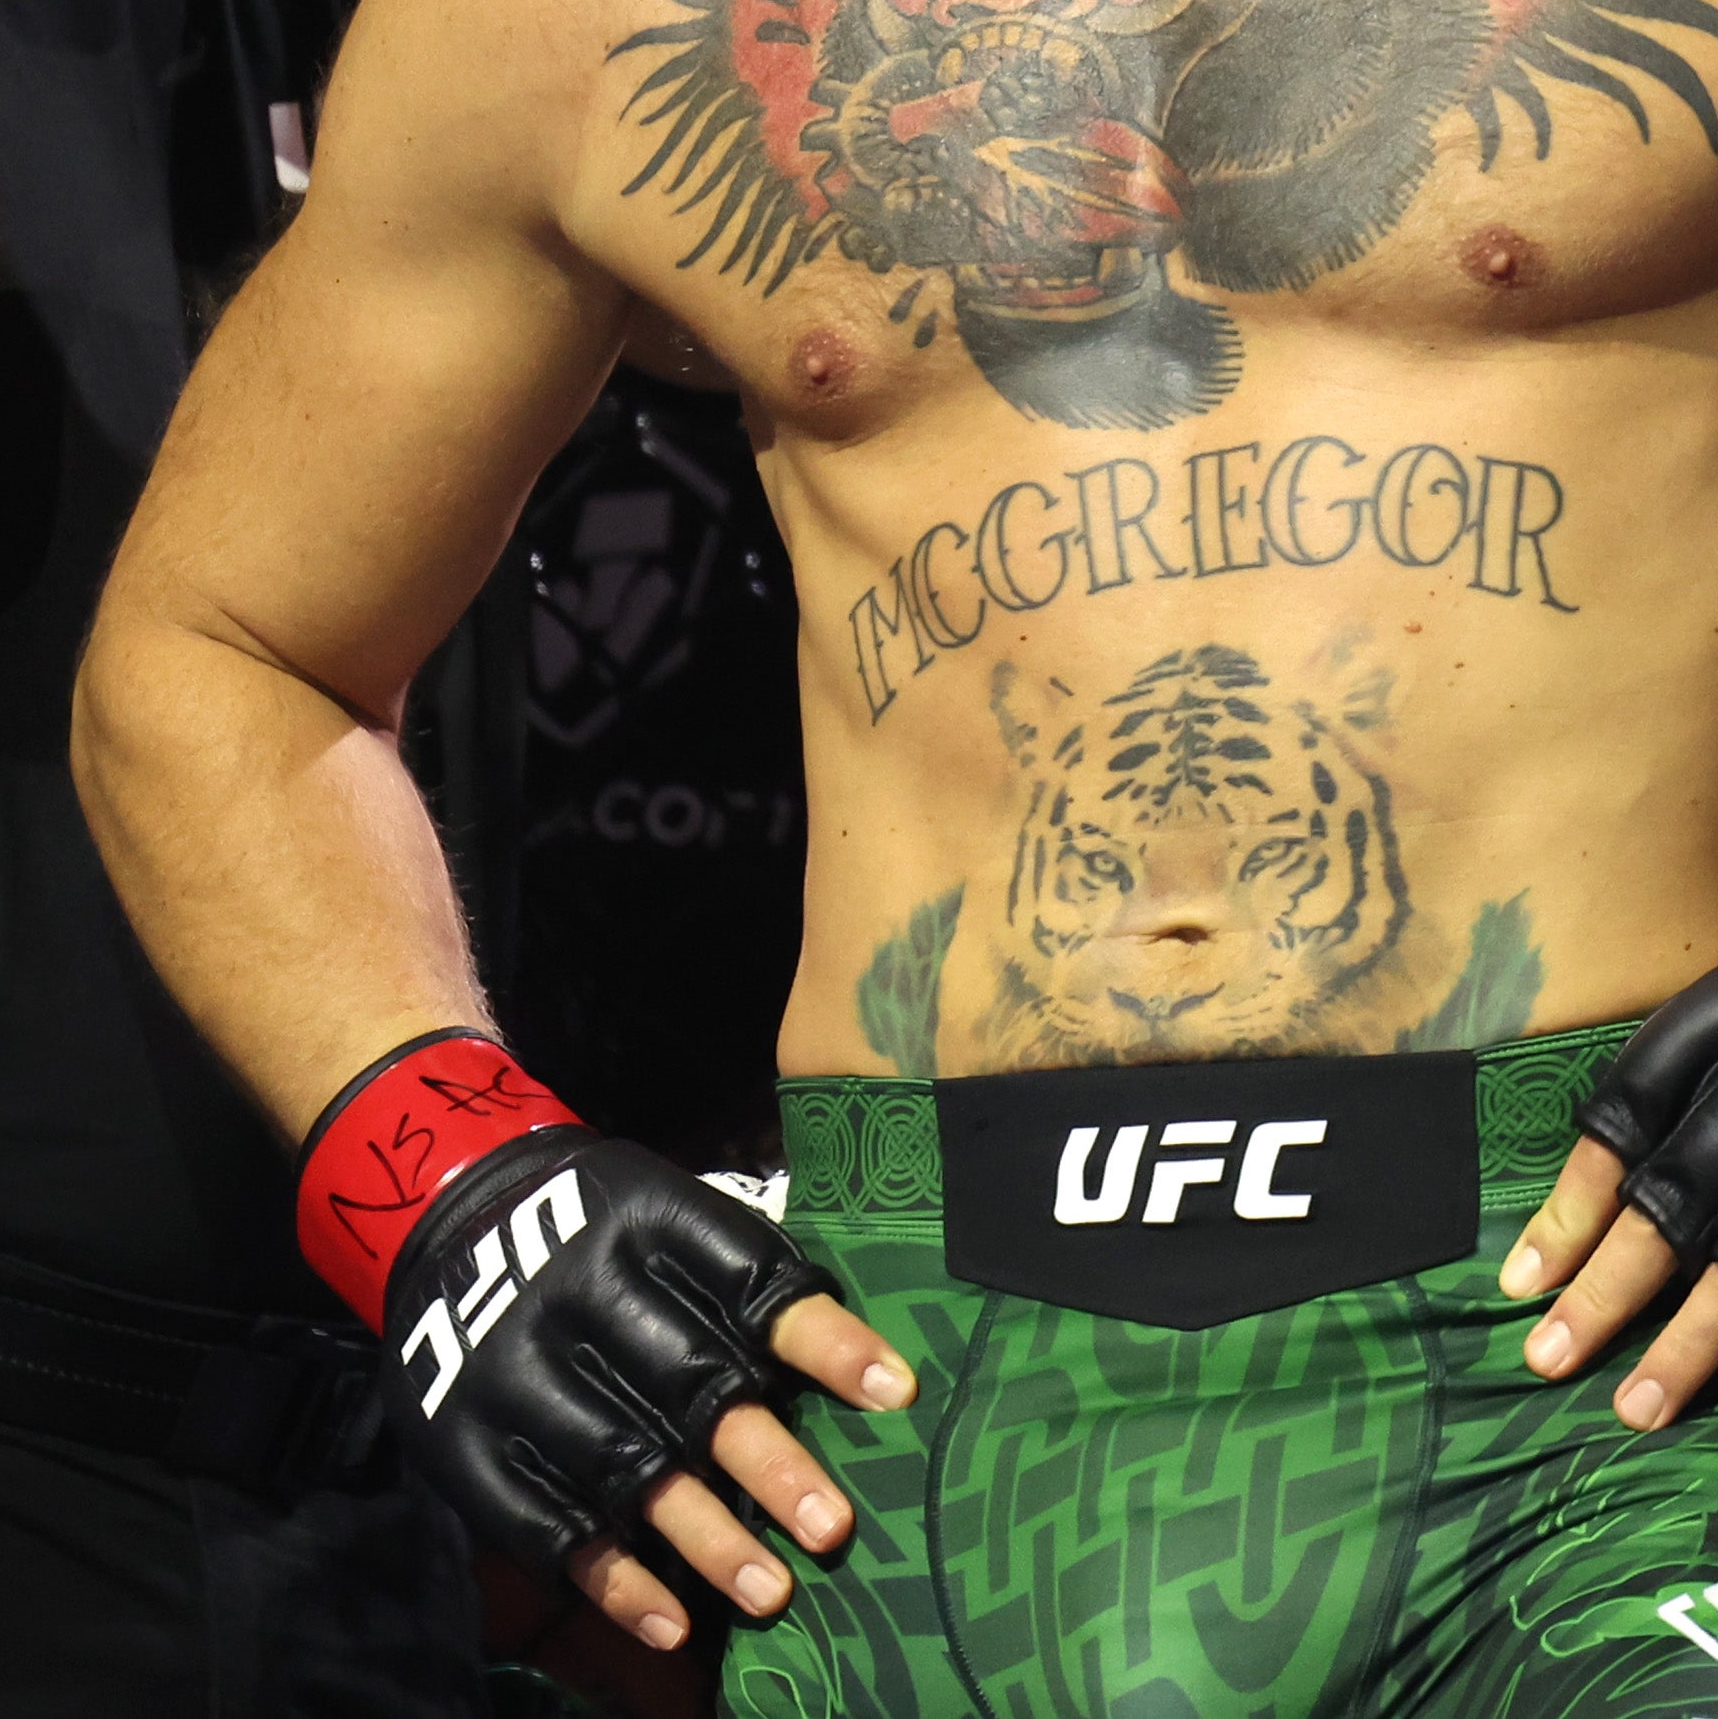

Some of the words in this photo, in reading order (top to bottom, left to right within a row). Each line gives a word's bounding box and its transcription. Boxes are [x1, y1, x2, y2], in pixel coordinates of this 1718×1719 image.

[847, 434, 1580, 726] MCGREGOR
[400, 1167, 588, 1421] UFC
[1054, 1118, 1329, 1225] UFC
